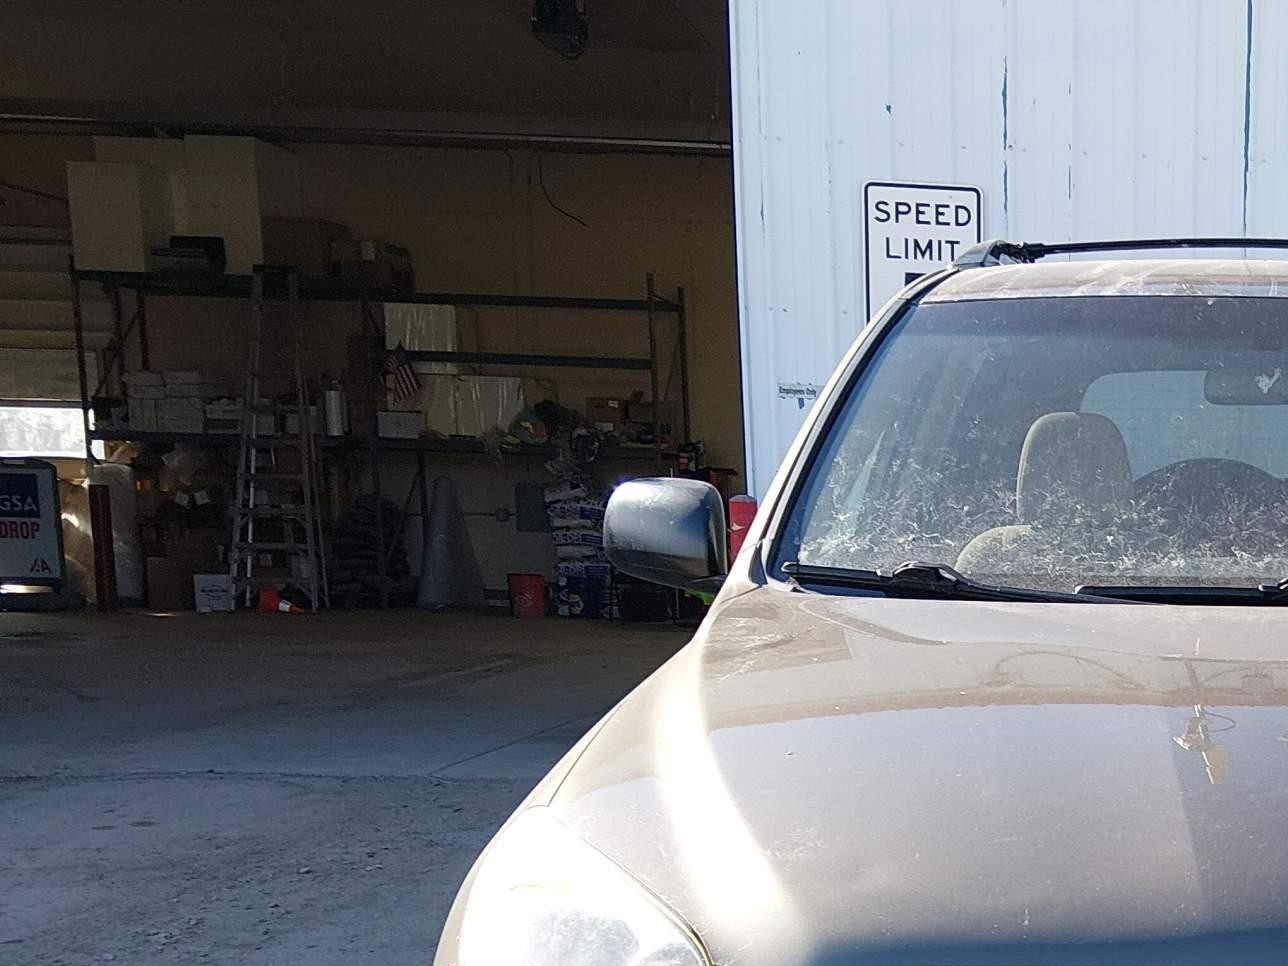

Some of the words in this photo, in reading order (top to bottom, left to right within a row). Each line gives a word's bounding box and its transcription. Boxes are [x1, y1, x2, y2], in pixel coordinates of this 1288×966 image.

[874, 200, 972, 226] SPEED
[885, 236, 960, 262] LIMIT
[779, 386, 805, 396] Employees
